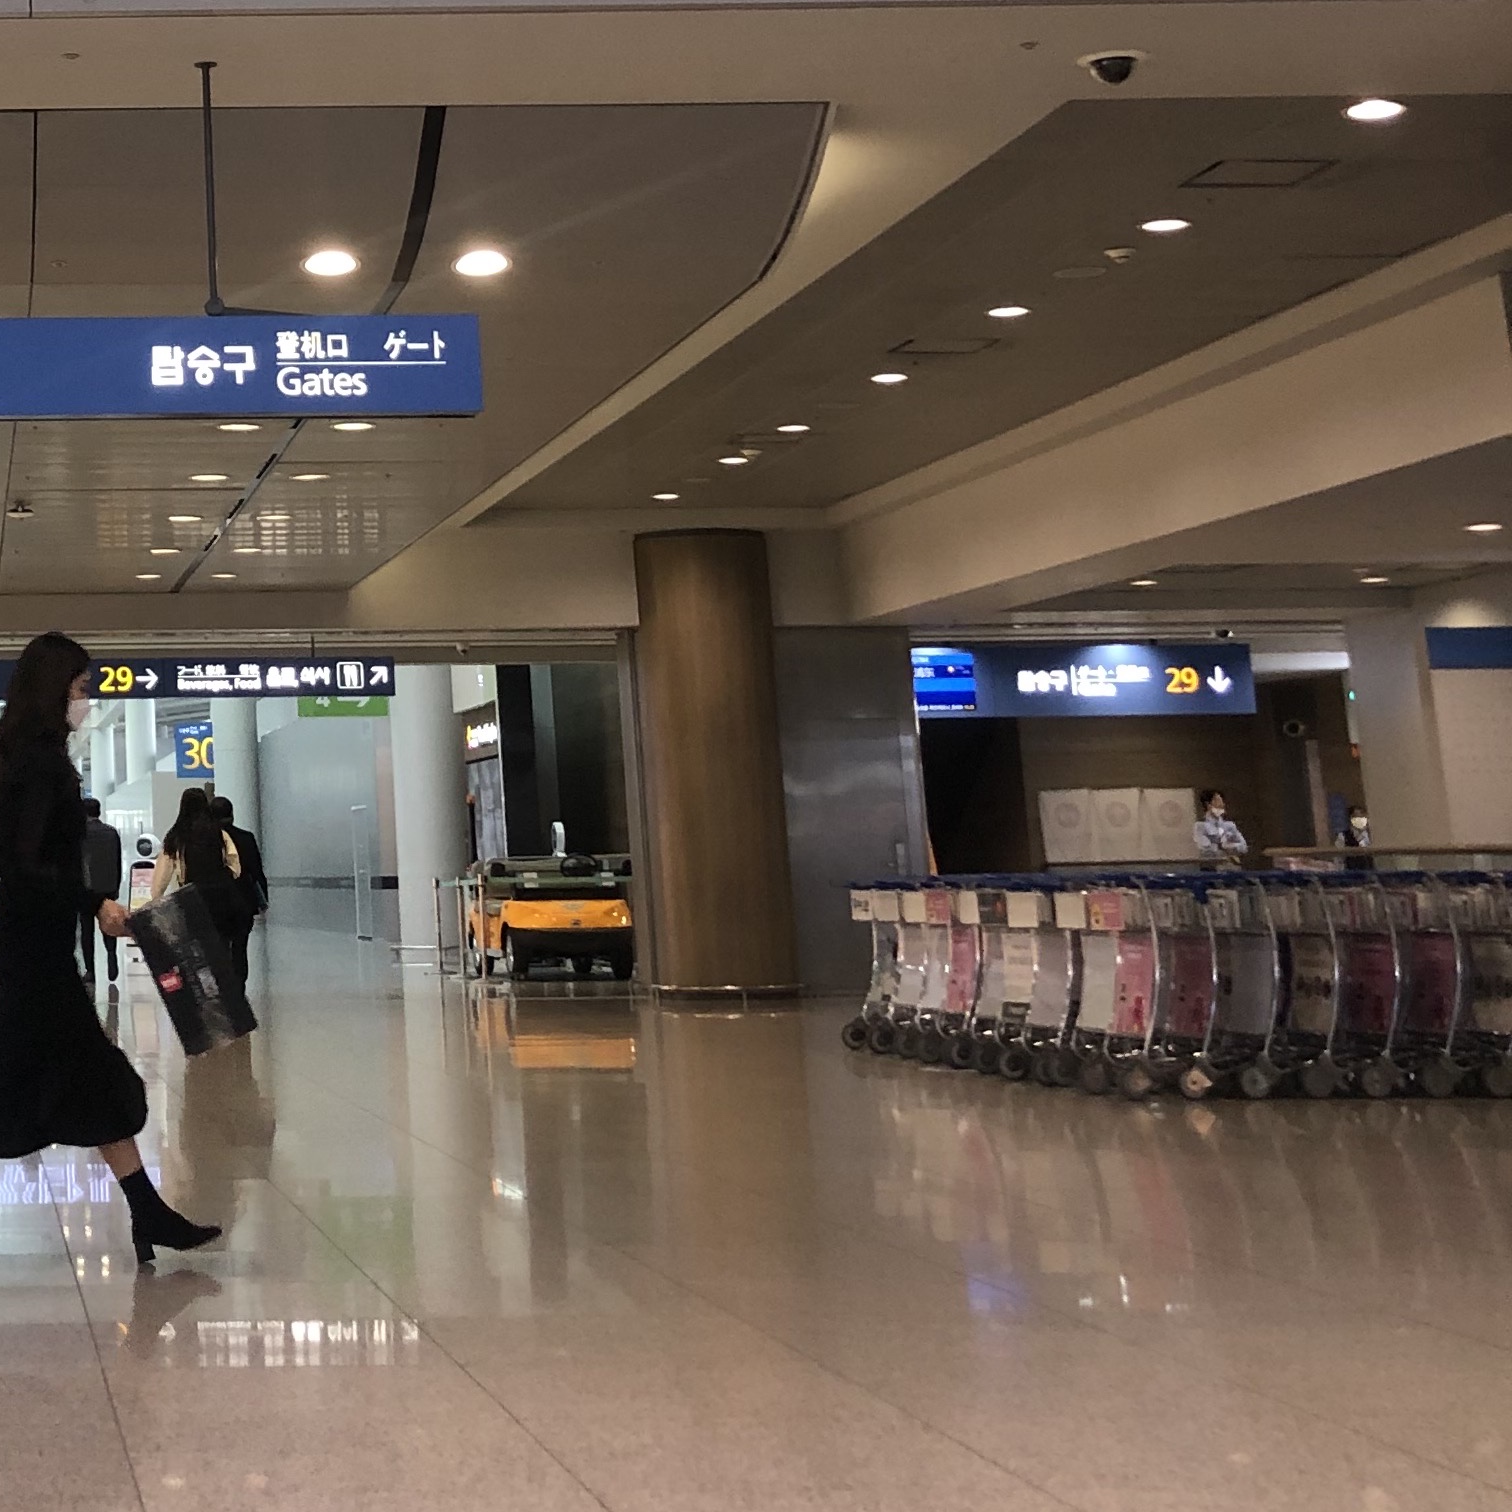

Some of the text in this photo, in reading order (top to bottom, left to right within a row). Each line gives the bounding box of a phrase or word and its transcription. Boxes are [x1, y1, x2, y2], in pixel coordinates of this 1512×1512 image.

[276, 331, 349, 359] 登机口
[383, 330, 447, 359] ゲート
[150, 344, 256, 386] 탑승구
[276, 366, 368, 399] Gates
[98, 666, 134, 692] 29
[1164, 667, 1200, 694] 29
